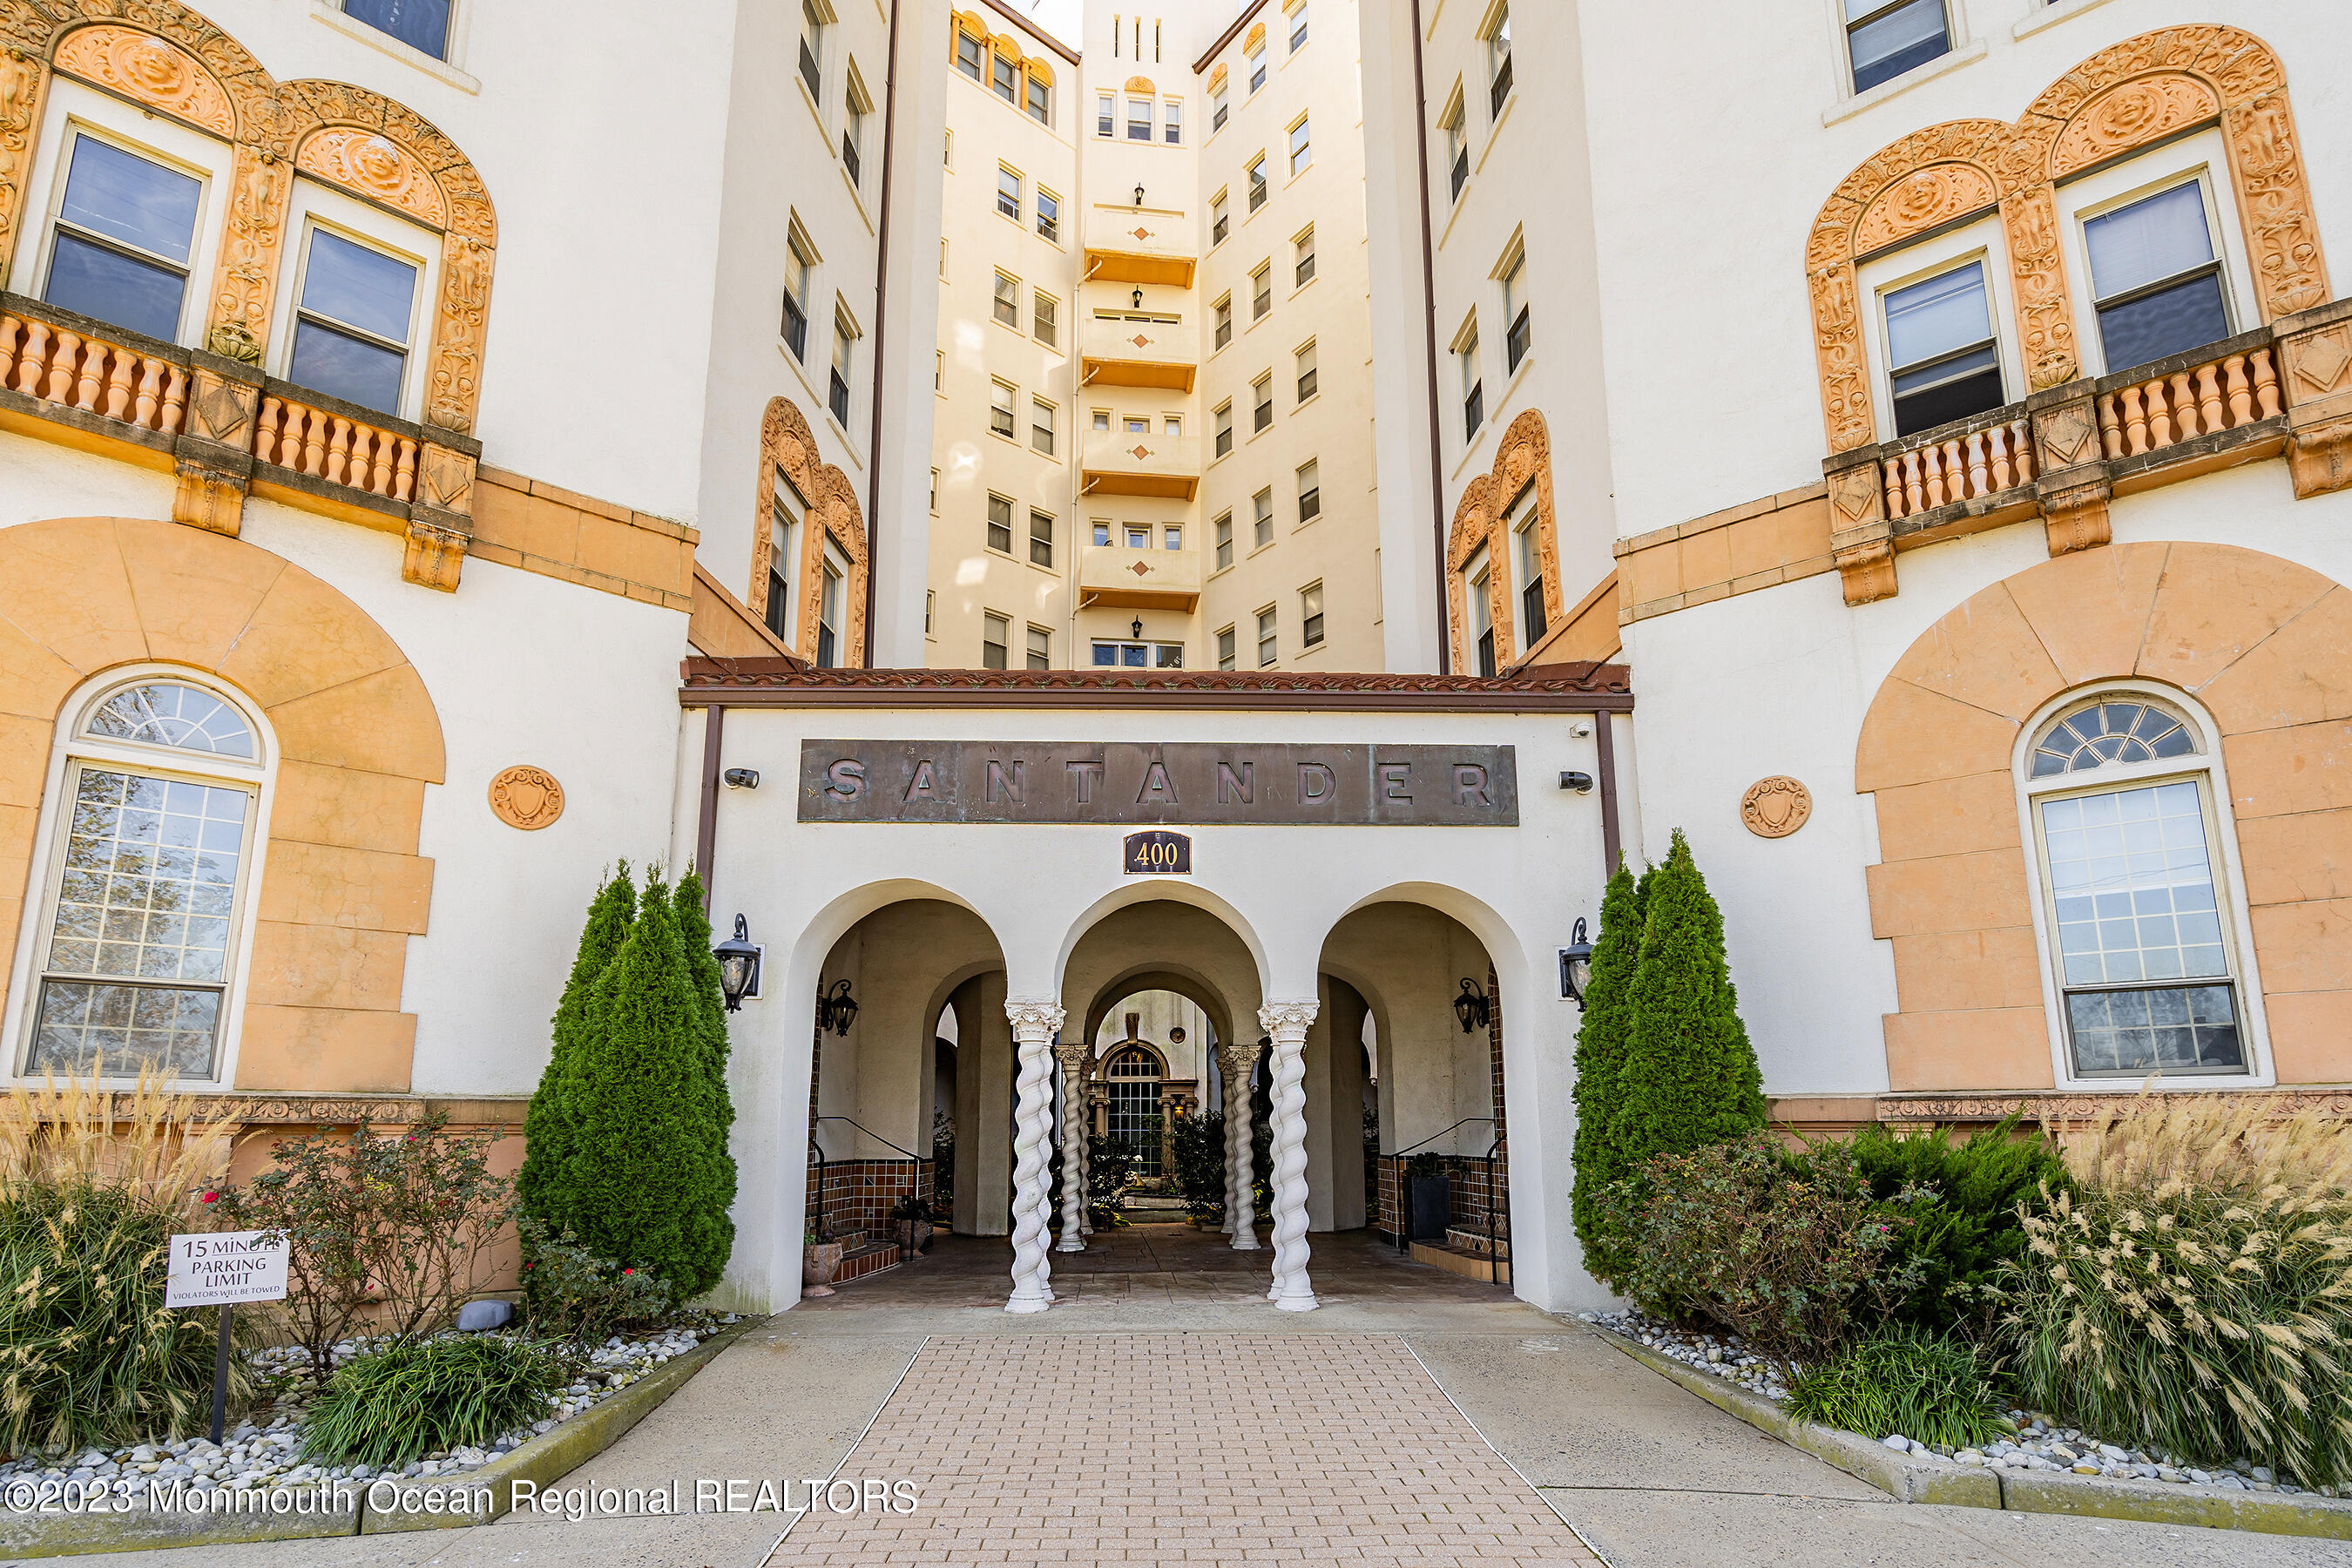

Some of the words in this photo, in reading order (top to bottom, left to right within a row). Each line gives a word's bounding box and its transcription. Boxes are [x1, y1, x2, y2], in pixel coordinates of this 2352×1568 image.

[825, 758, 1490, 807] SANTANDER
[1136, 842, 1178, 866] 400
[183, 1240, 207, 1258] 15
[192, 1257, 267, 1274] PARKING
[206, 1272, 252, 1288] LIMIT
[173, 1290, 218, 1300] VIOLATORS
[252, 1285, 280, 1294] TOWED
